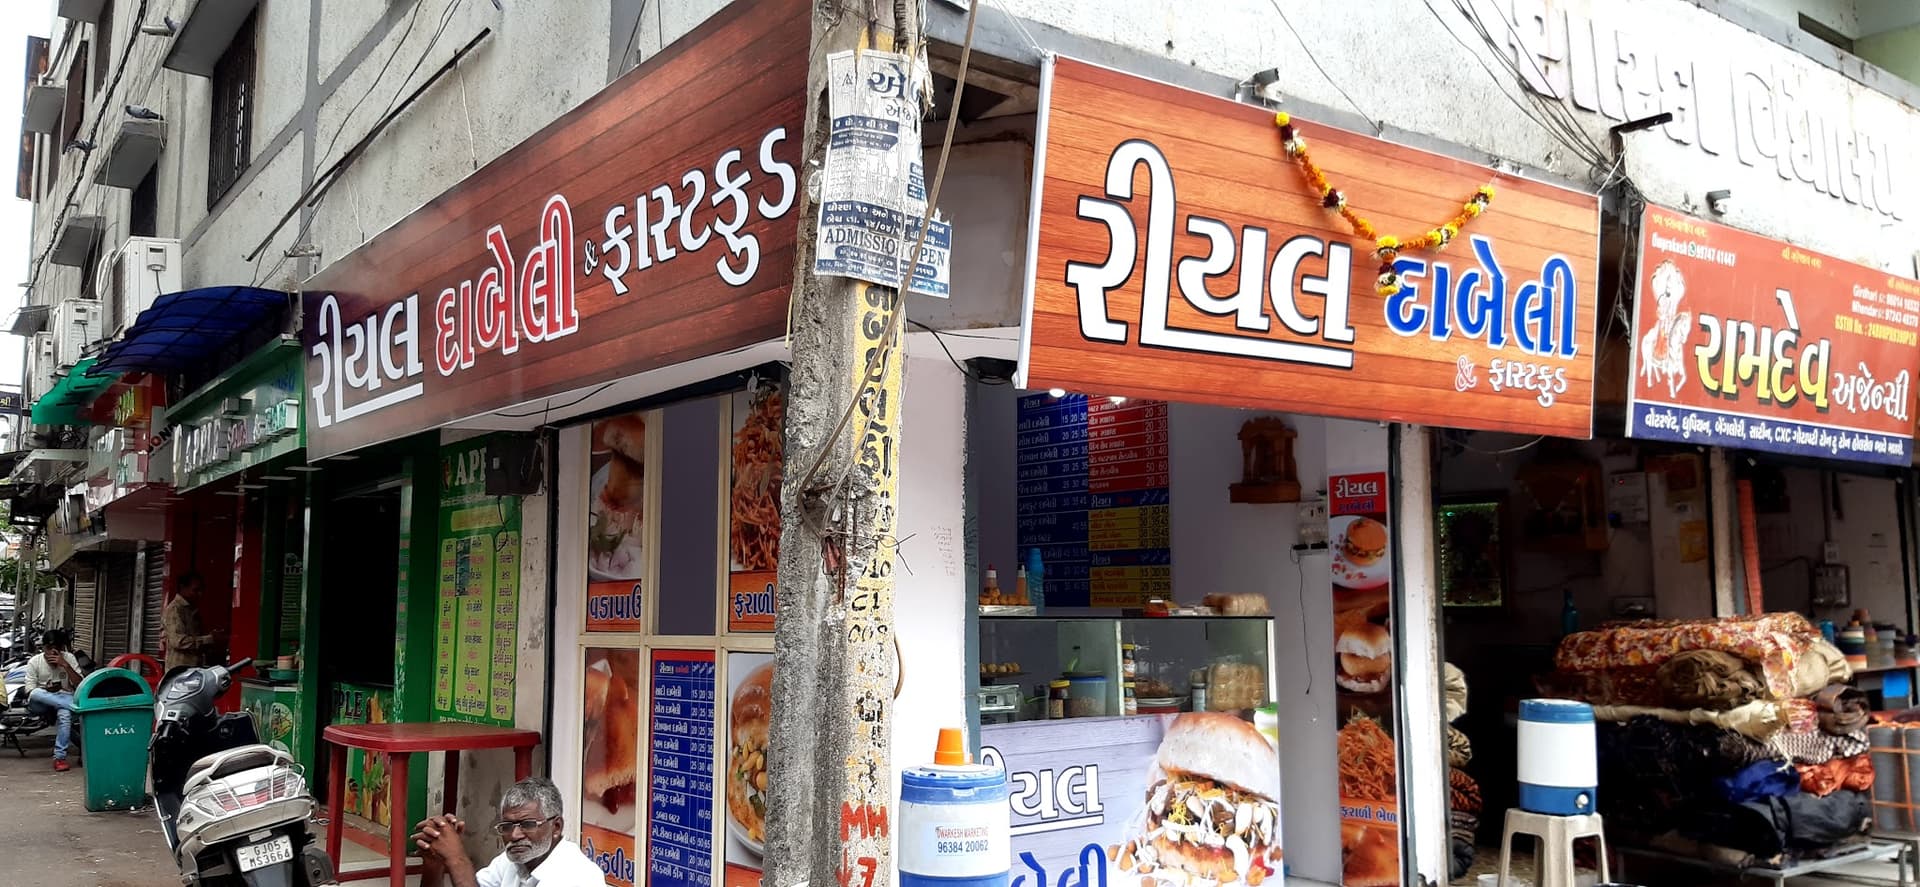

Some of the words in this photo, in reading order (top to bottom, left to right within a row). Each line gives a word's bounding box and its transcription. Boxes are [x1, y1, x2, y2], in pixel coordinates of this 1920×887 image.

[871, 205, 889, 219] અને
[1066, 139, 1355, 370] રીયલ
[312, 295, 424, 428] રીયલ
[436, 194, 579, 377] દાબેલી
[584, 239, 599, 277] &
[1383, 233, 1579, 360] દાબેલી
[1695, 287, 1831, 412] રામદેવ
[1455, 354, 1477, 393] &
[1775, 426, 1791, 443] CXC
[1335, 477, 1378, 499] રીયલ
[254, 840, 281, 856] GJ05
[937, 841, 963, 853] 96384
[965, 840, 989, 852] 20062
